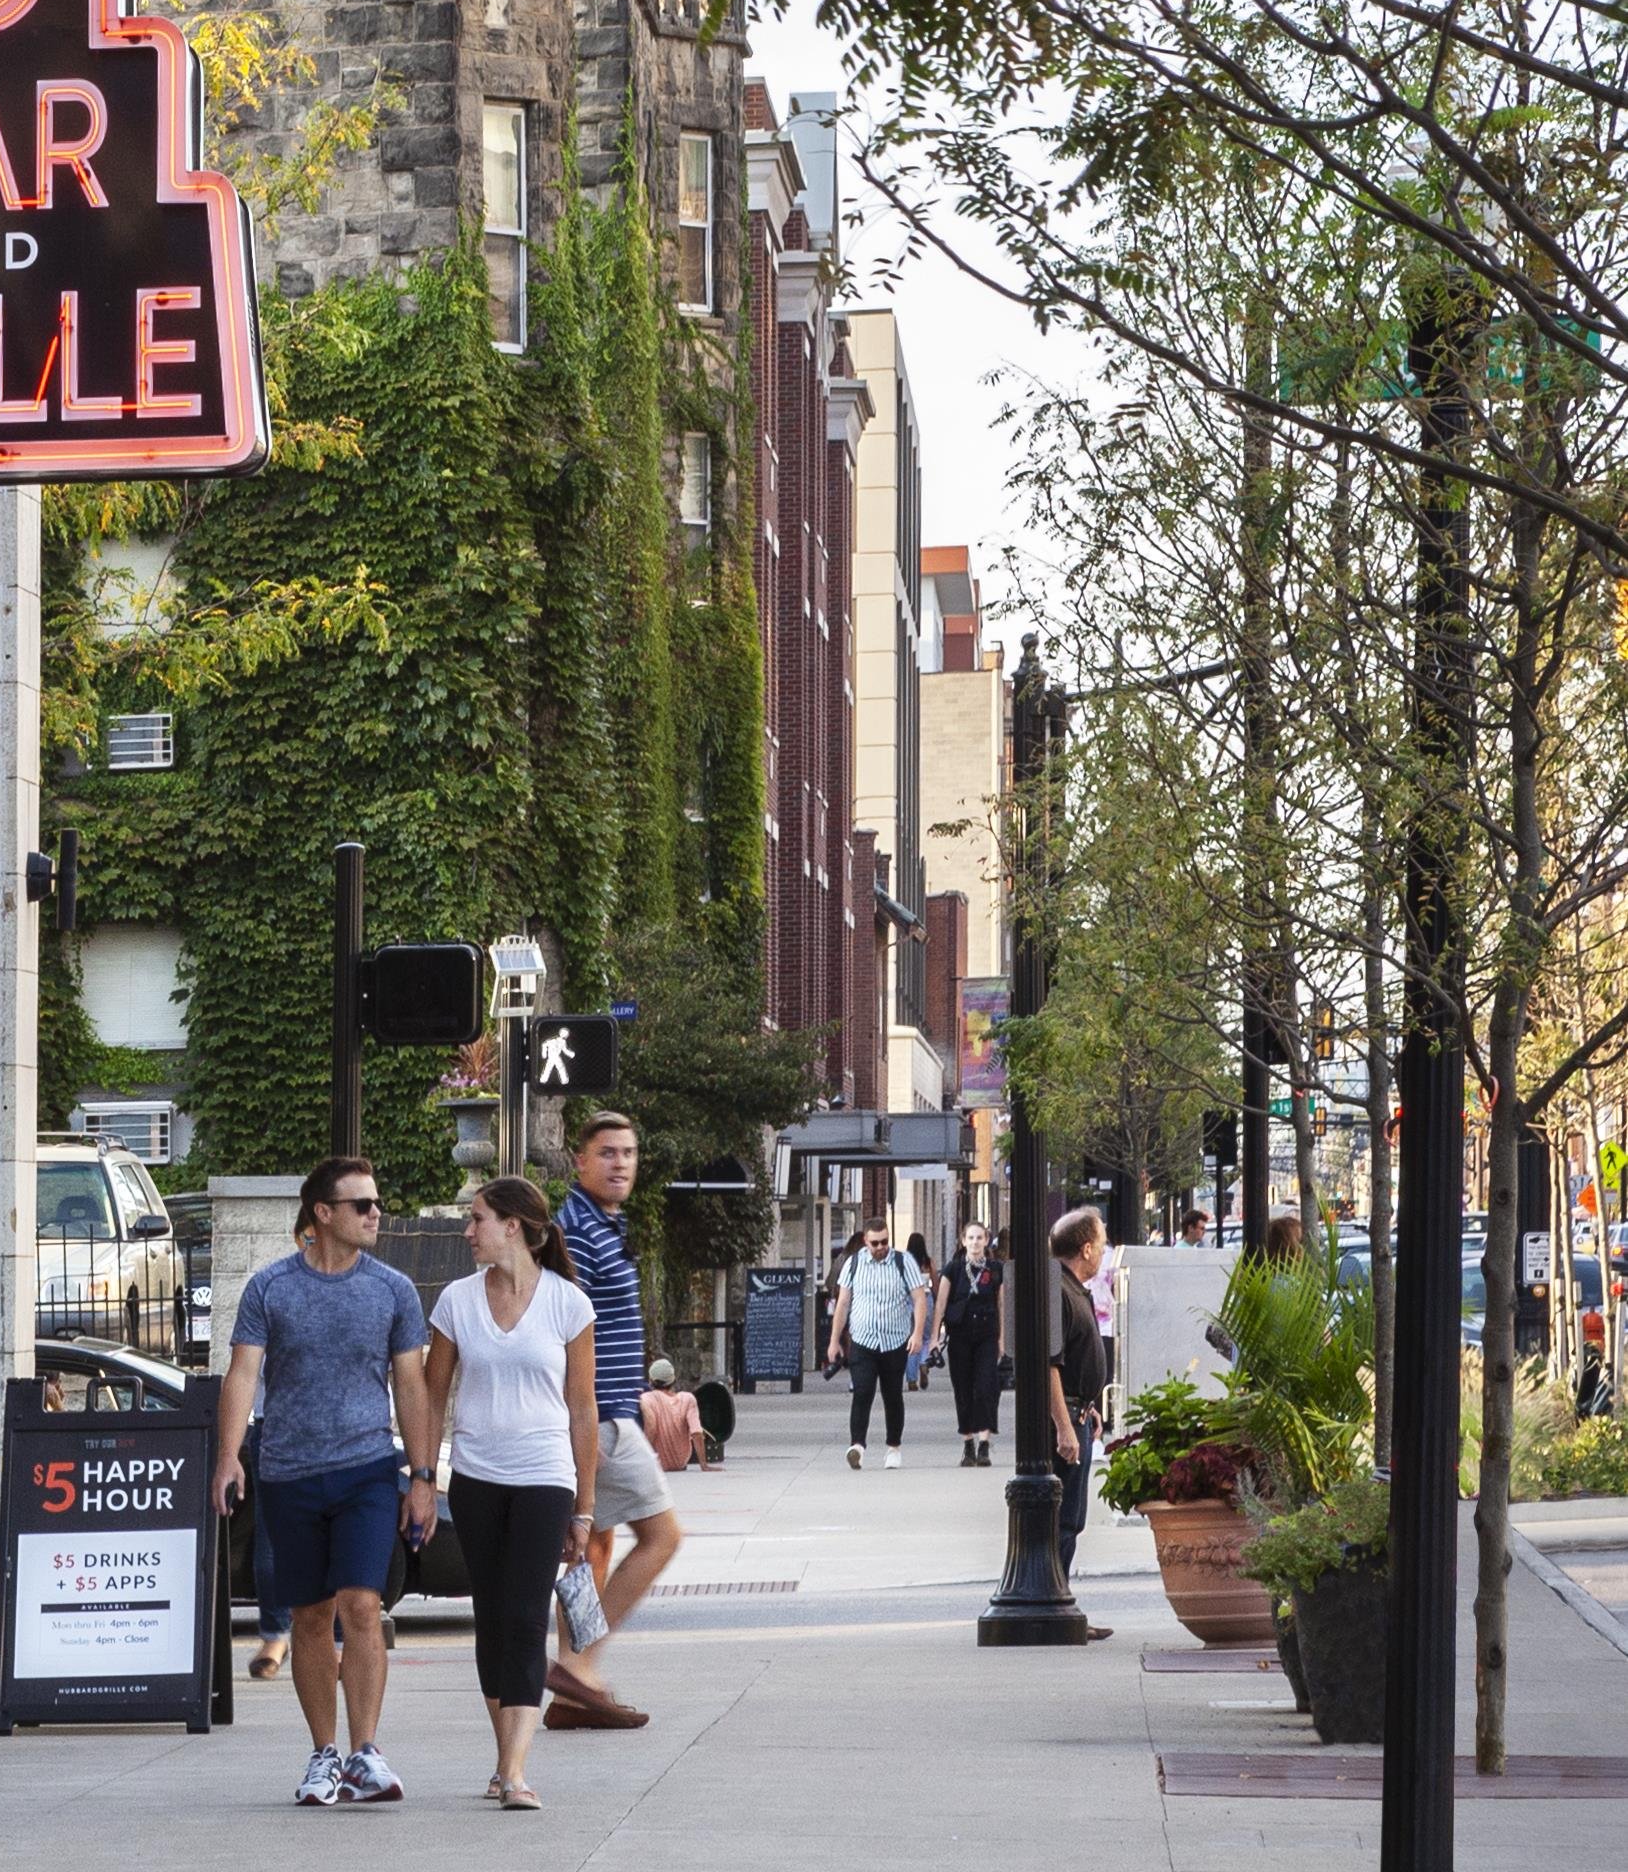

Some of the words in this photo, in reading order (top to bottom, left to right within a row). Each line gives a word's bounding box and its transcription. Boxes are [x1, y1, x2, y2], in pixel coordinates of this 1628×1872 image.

[33, 1461, 76, 1513] $5
[83, 1458, 185, 1483] HAPPY
[83, 1487, 173, 1512] HOUR
[53, 1553, 75, 1570] $5
[84, 1551, 161, 1568] DRINKS
[75, 1575, 97, 1592] $5
[105, 1574, 156, 1590] APPS
[110, 1619, 131, 1629] 4pm
[138, 1618, 159, 1628] 6pm
[95, 1635, 116, 1645] 4pm
[124, 1634, 150, 1644] Close
[58, 1685, 148, 1695] HUBBARDGRILLECOM
